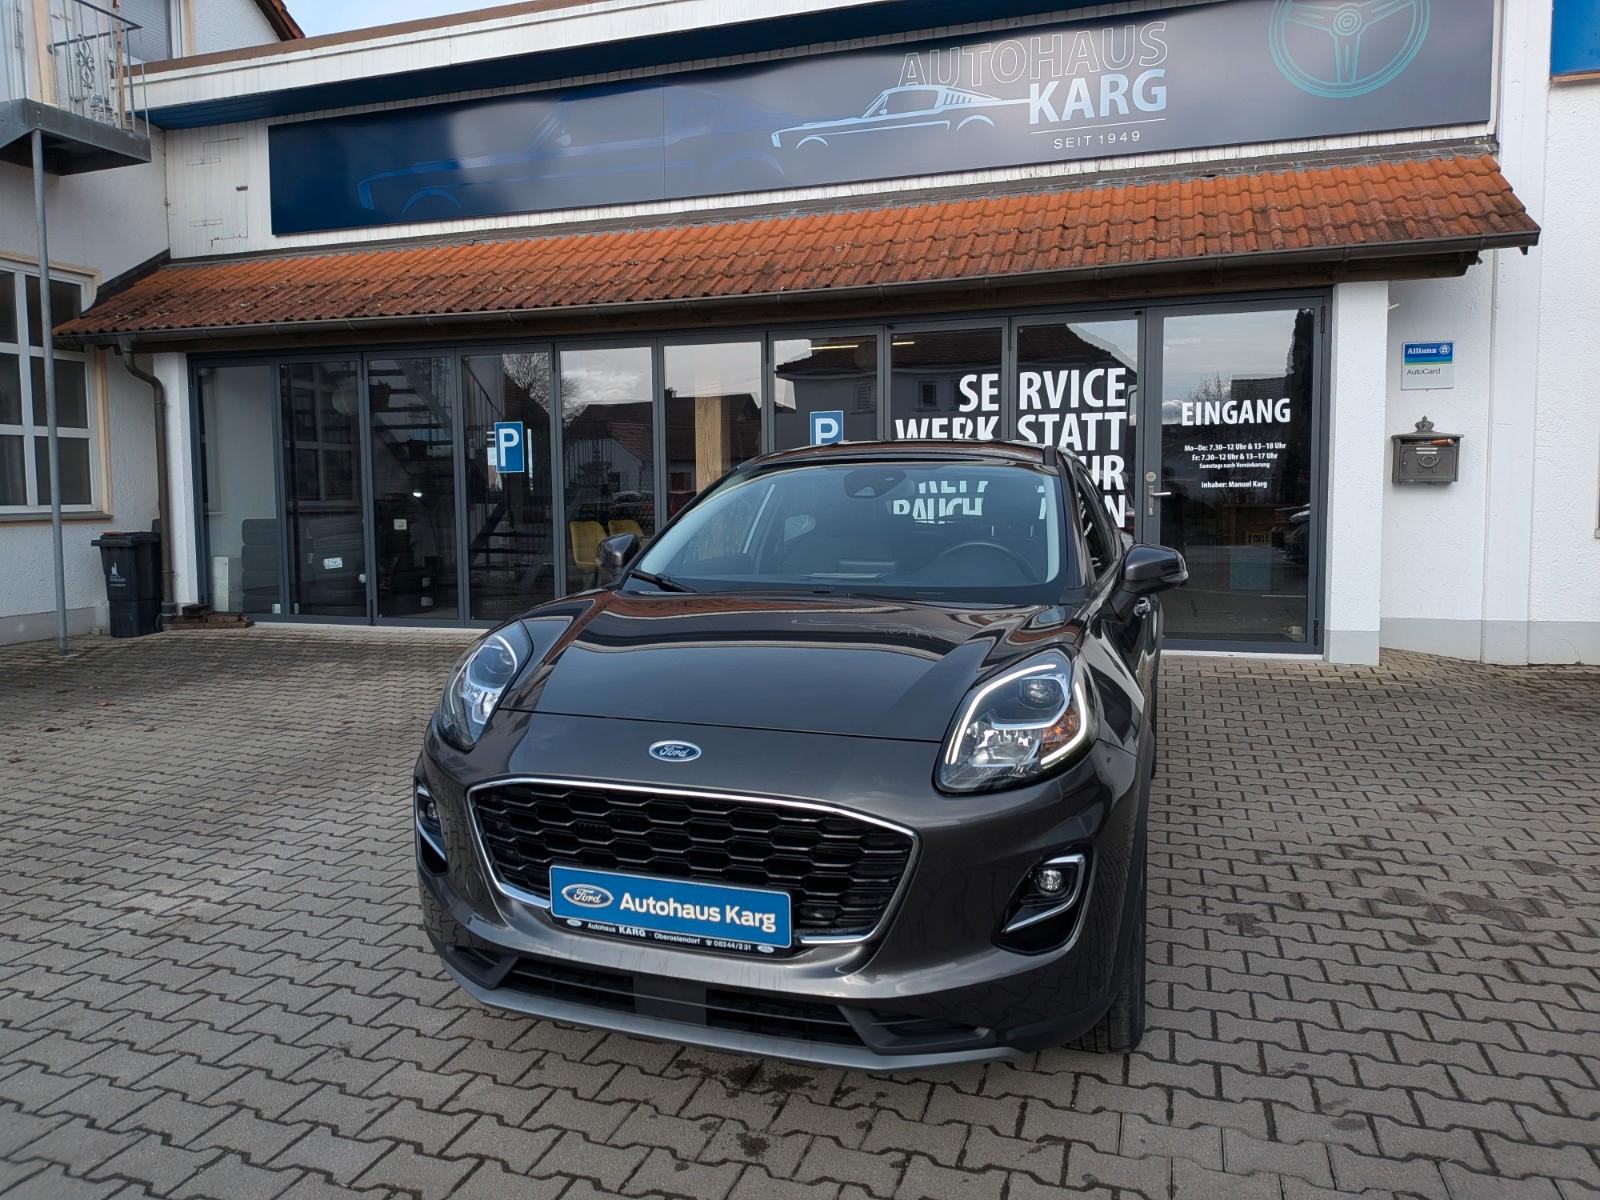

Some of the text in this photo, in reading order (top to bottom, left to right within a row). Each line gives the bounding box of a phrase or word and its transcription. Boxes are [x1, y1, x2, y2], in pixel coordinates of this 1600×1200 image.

[898, 21, 1168, 88] AUTOHAUS
[1029, 68, 1167, 125] KARG
[1053, 130, 1141, 149] SEIT 1949
[1407, 347, 1437, 355] Allianz
[1406, 367, 1441, 376] AutoCard
[1181, 398, 1291, 426] EINGANG
[499, 428, 520, 467] P
[1274, 441, 1286, 449] Uhr
[1201, 481, 1228, 489] Inhaber:
[1252, 480, 1268, 489] Karg
[659, 745, 690, 758] Ford
[573, 888, 777, 933] Ford Autohaus Karg
[587, 922, 616, 933] Autohaus
[618, 926, 646, 937] KARG
